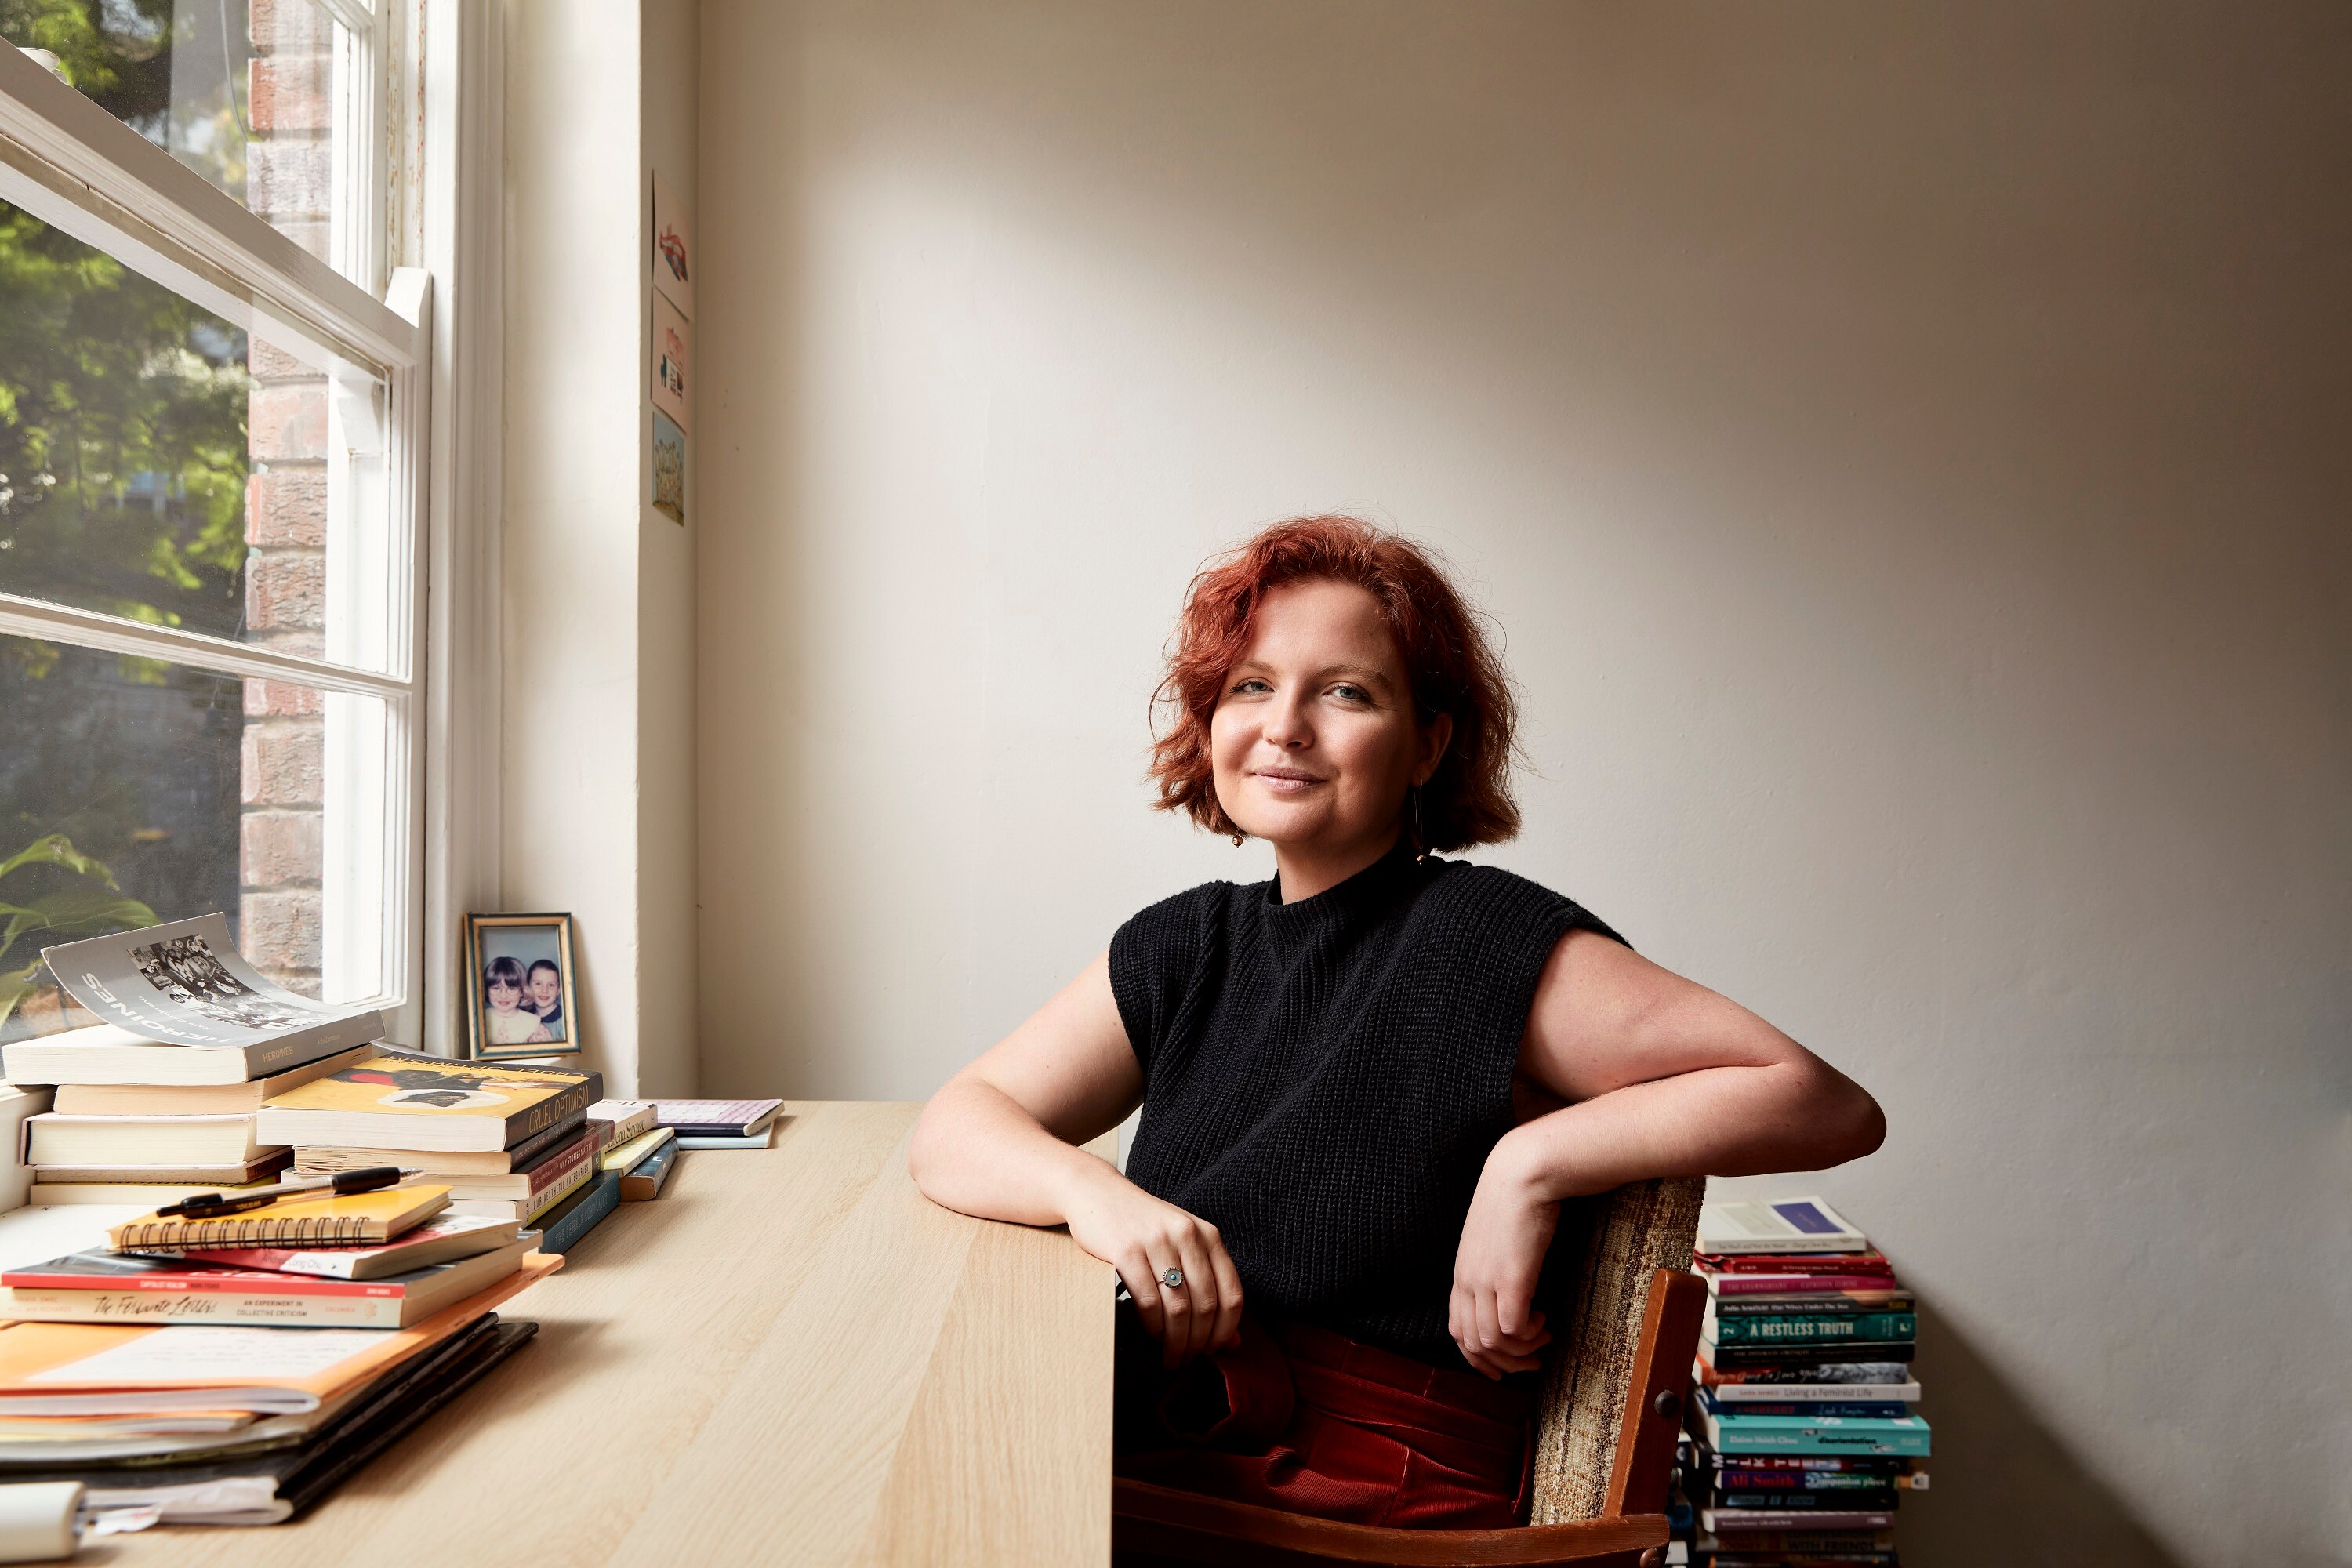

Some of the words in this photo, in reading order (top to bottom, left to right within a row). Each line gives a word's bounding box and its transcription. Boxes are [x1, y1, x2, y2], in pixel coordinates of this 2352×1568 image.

[82, 972, 231, 1043] HEROINES
[263, 1045, 294, 1063] HEROINES
[528, 1103, 552, 1133] CRUEL
[554, 1085, 589, 1120] OPTIMISM
[626, 1120, 645, 1138] Savage
[559, 1160, 568, 1171] WHY
[567, 1150, 581, 1164] STORIES
[580, 1142, 593, 1157] MATTER
[533, 1196, 543, 1210] OUR
[543, 1180, 565, 1203] AESTHETIC
[566, 1163, 589, 1186] CATEGORIES
[288, 1255, 306, 1269] Long
[307, 1258, 322, 1269] Chu
[94, 1295, 113, 1315] The
[1750, 1323, 1759, 1337] A
[1762, 1323, 1814, 1337] RESTLESS
[1818, 1322, 1854, 1336] TRUTH
[1784, 1388, 1809, 1399] Living
[1818, 1388, 1855, 1396] Feminist
[1856, 1388, 1873, 1397] Life
[1817, 1436, 1877, 1445] disorientation
[1711, 1454, 1765, 1468] MILK
[1774, 1458, 1842, 1470] TEETH
[1730, 1474, 1751, 1487] Ali
[1753, 1474, 1795, 1487] Smith
[1862, 1477, 1886, 1487] piece
